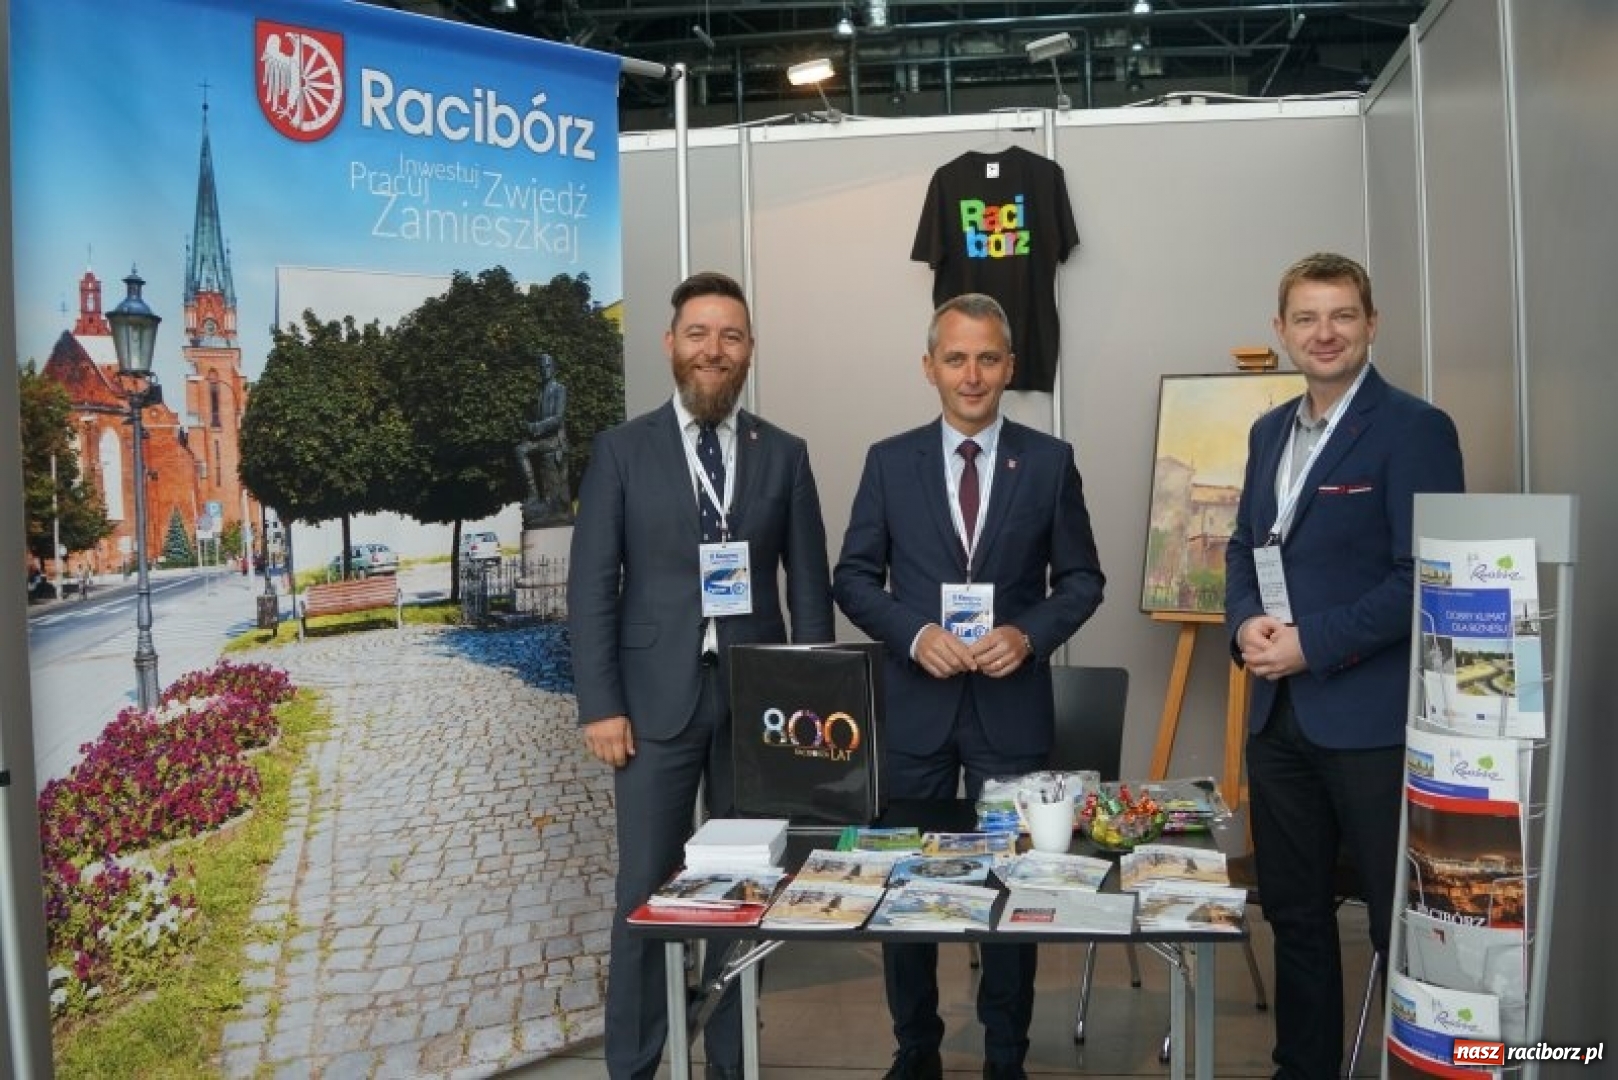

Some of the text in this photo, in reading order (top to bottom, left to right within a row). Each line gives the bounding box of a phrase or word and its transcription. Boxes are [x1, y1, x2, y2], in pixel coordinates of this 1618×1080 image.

[361, 68, 596, 160] Racibórz
[350, 160, 430, 203] Pracuj
[400, 151, 482, 188] Inwestuj
[482, 172, 588, 219] Zwiedź
[960, 194, 1024, 232] Raci
[371, 193, 579, 264] Zamieszkaj
[763, 708, 860, 750] 800
